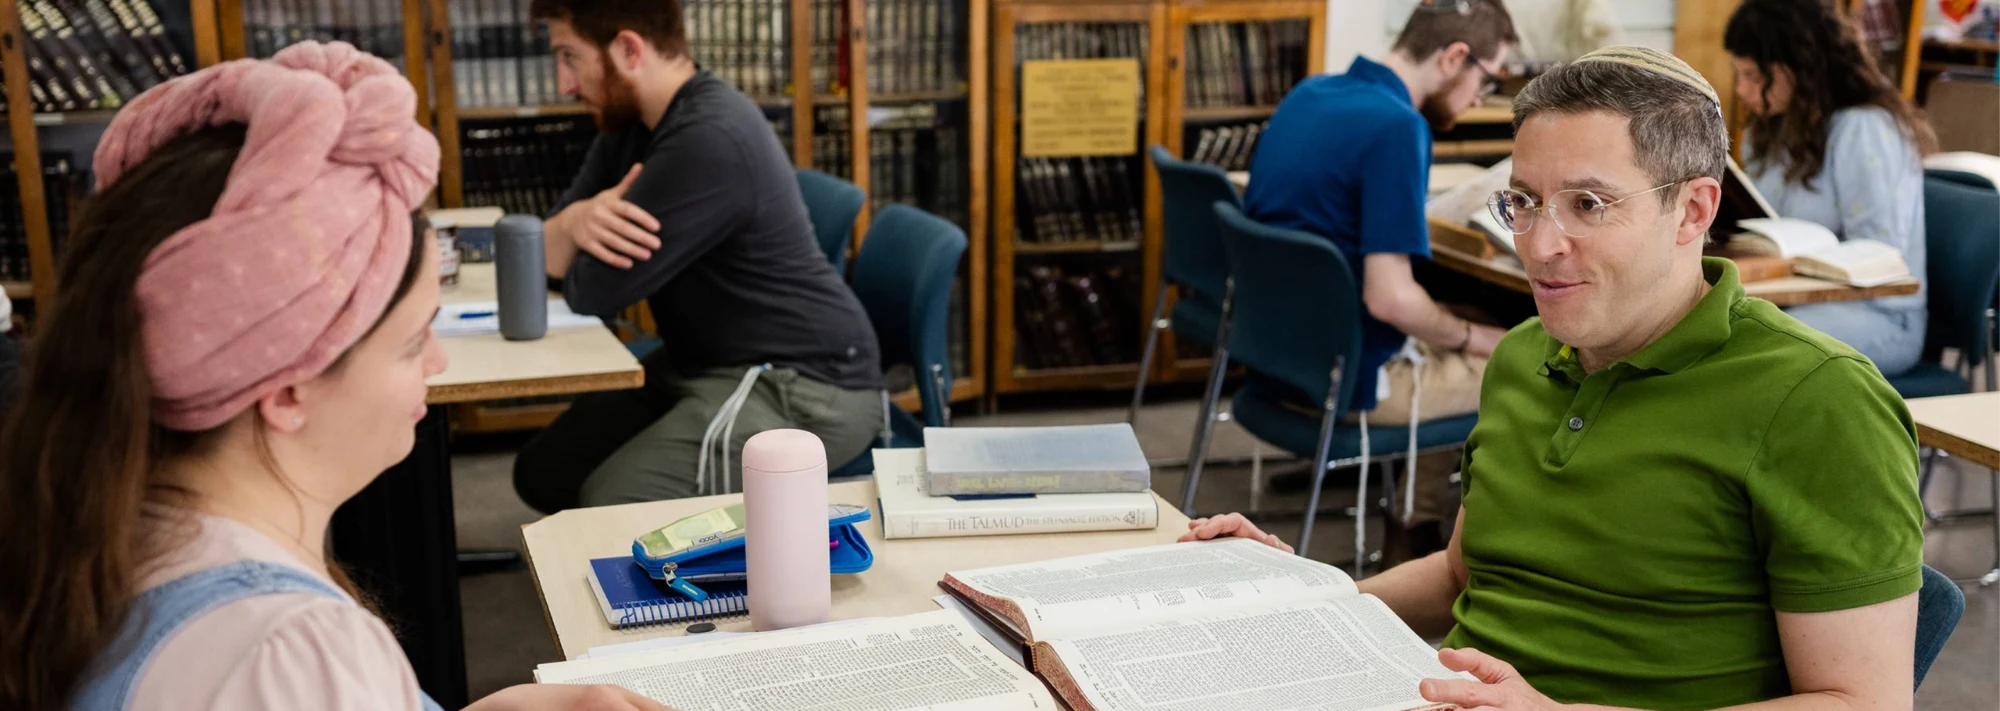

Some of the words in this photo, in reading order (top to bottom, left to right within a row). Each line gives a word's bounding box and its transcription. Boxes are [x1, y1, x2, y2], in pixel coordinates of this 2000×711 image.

[946, 517, 968, 530] THE
[969, 516, 1025, 529] TALMUD
[1026, 517, 1040, 525] THE
[1088, 515, 1120, 524] EDITION
